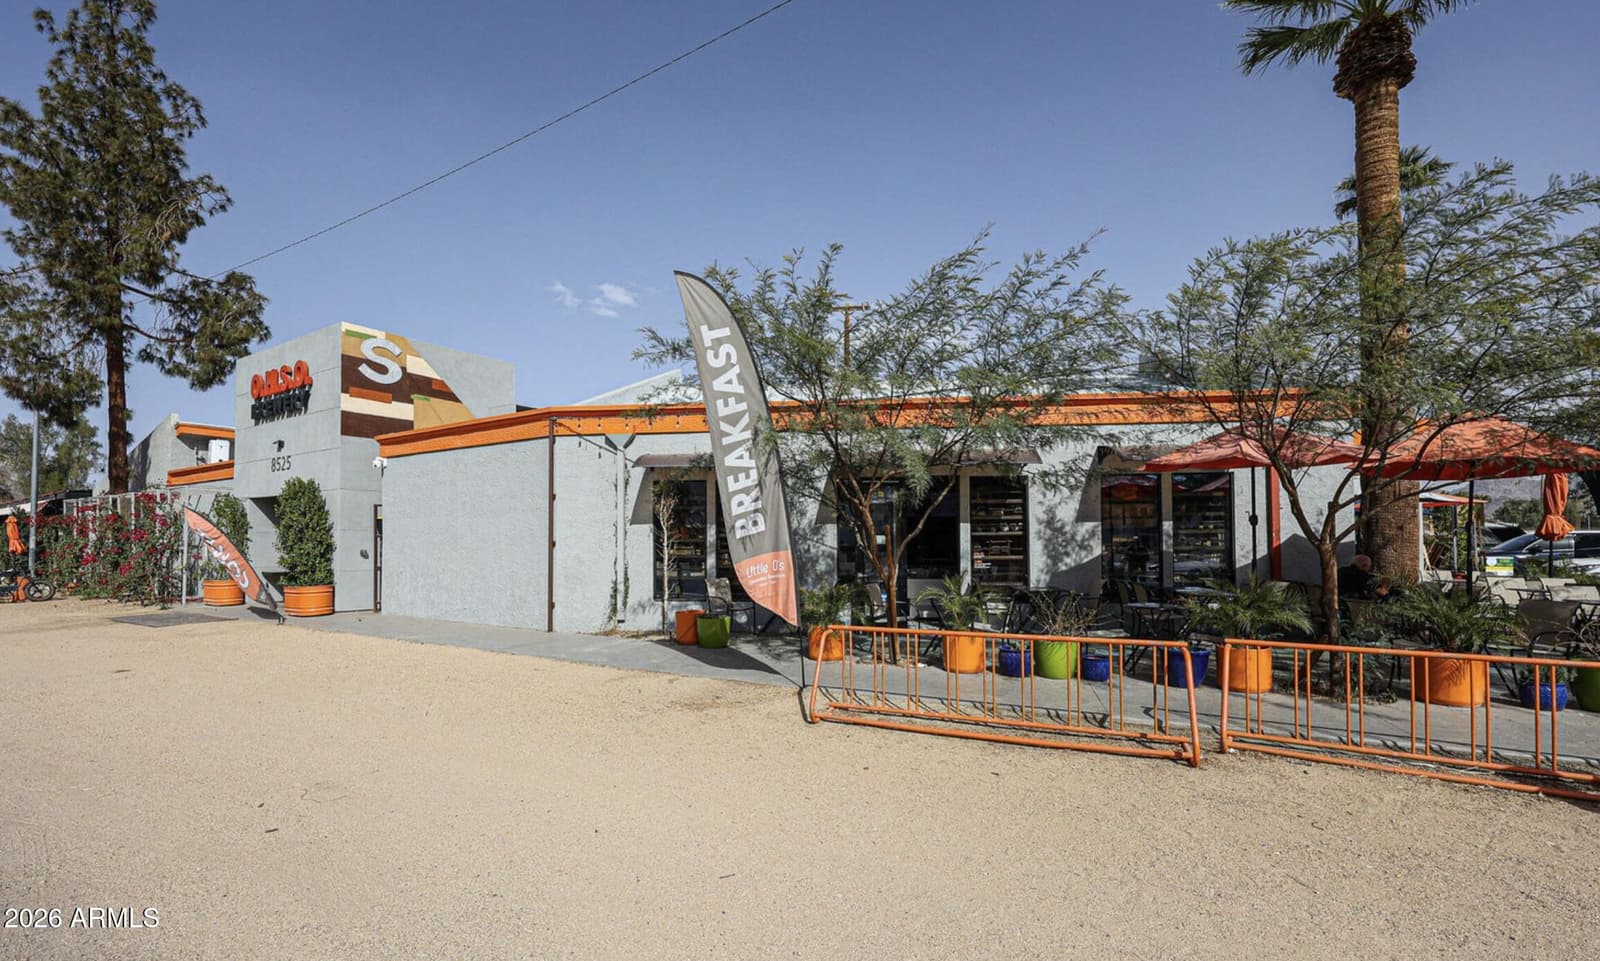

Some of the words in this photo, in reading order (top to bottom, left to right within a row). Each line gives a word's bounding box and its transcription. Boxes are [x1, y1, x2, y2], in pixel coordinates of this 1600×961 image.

[357, 338, 403, 385] S
[700, 324, 767, 540] BREAKFAST
[270, 455, 292, 473] 8525
[746, 563, 769, 579] Little
